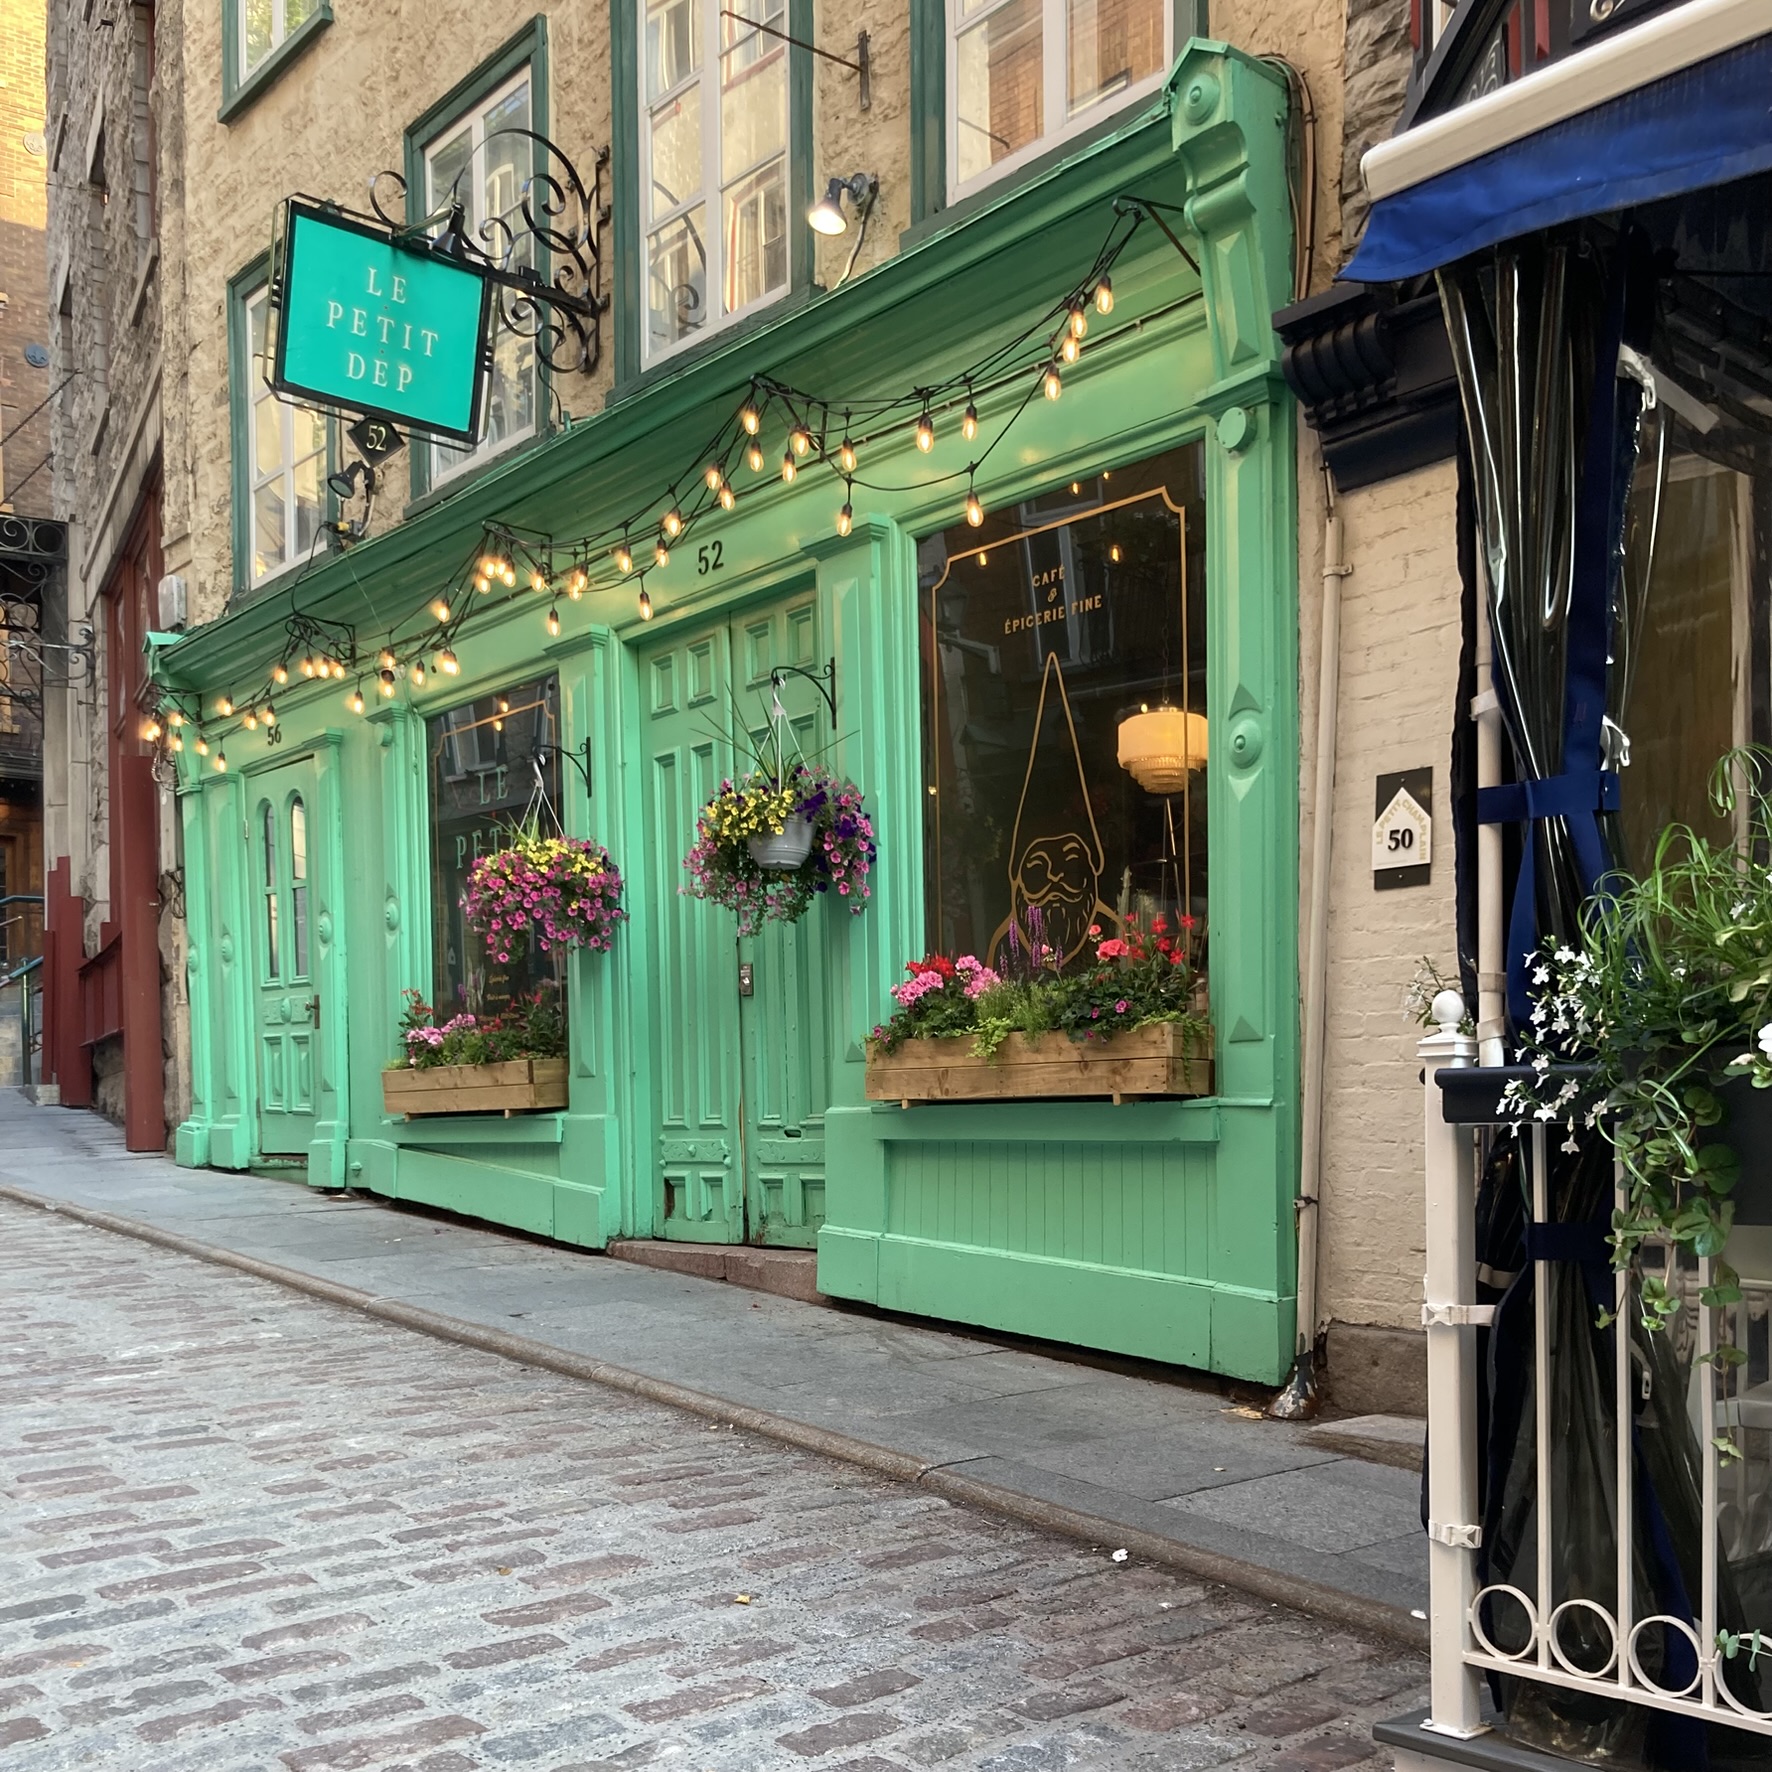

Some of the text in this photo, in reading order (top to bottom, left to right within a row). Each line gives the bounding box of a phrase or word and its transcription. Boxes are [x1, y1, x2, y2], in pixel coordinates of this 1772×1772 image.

[366, 267, 406, 304] LE
[326, 300, 439, 358] PETIT
[346, 351, 413, 393] DEP
[366, 424, 387, 452] 52
[697, 540, 724, 576] 52
[1032, 563, 1066, 587] CAFÉ
[1004, 594, 1102, 635] ÉPICERIE FINE
[267, 723, 282, 747] 56
[477, 763, 509, 805] LE
[1378, 799, 1402, 829] PETIT
[1387, 827, 1414, 852] 50
